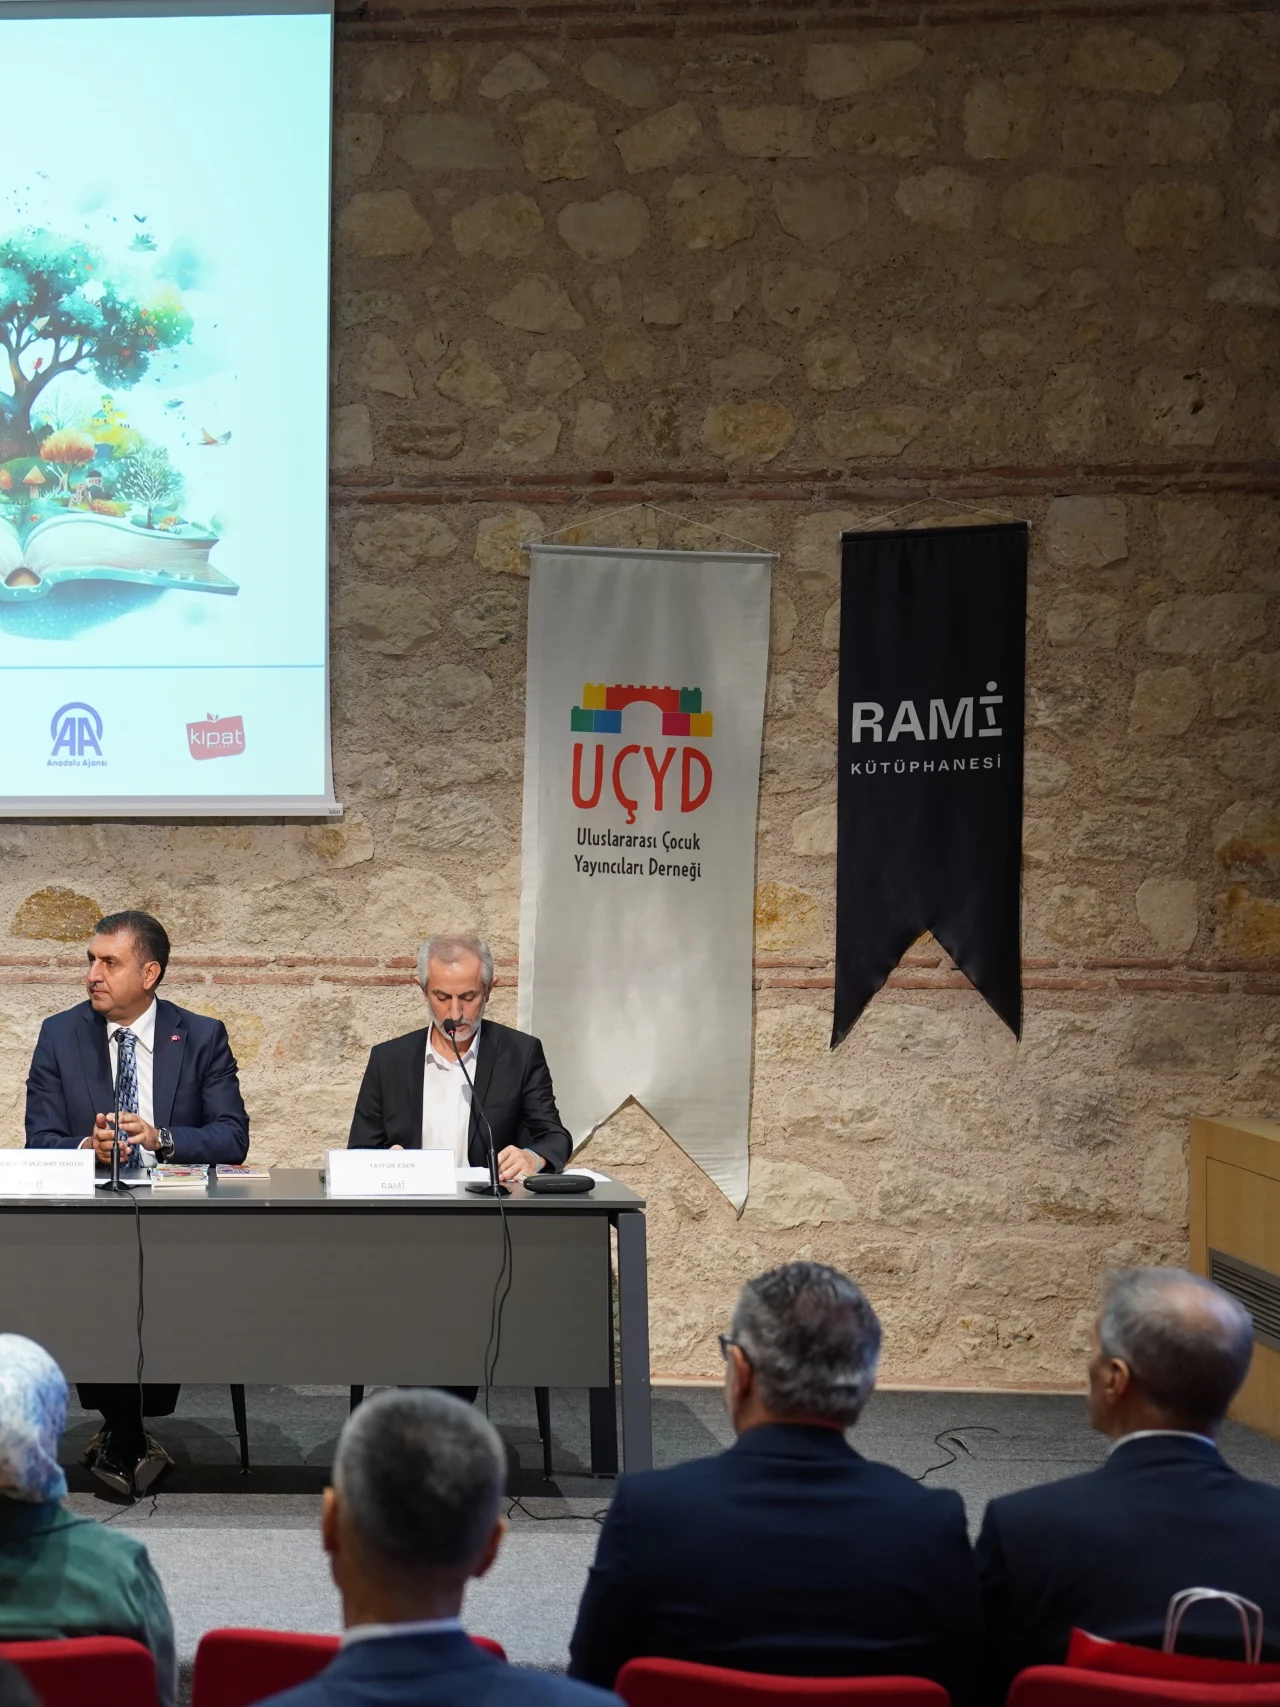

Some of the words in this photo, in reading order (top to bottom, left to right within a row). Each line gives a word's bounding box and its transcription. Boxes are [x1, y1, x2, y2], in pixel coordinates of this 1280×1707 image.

[851, 680, 1003, 743] RAMİ
[51, 717, 103, 756] AA
[190, 728, 242, 749] kipat
[47, 759, 80, 767] Anadolu
[82, 759, 107, 768] Ajansı
[851, 754, 1001, 775] KÜTÜPHANESİ
[572, 743, 713, 825] UÇYD
[577, 827, 657, 849] Uluslararası
[662, 831, 700, 853] Çocuk
[574, 855, 643, 877] Yayıncıları
[649, 857, 701, 882] Derneği
